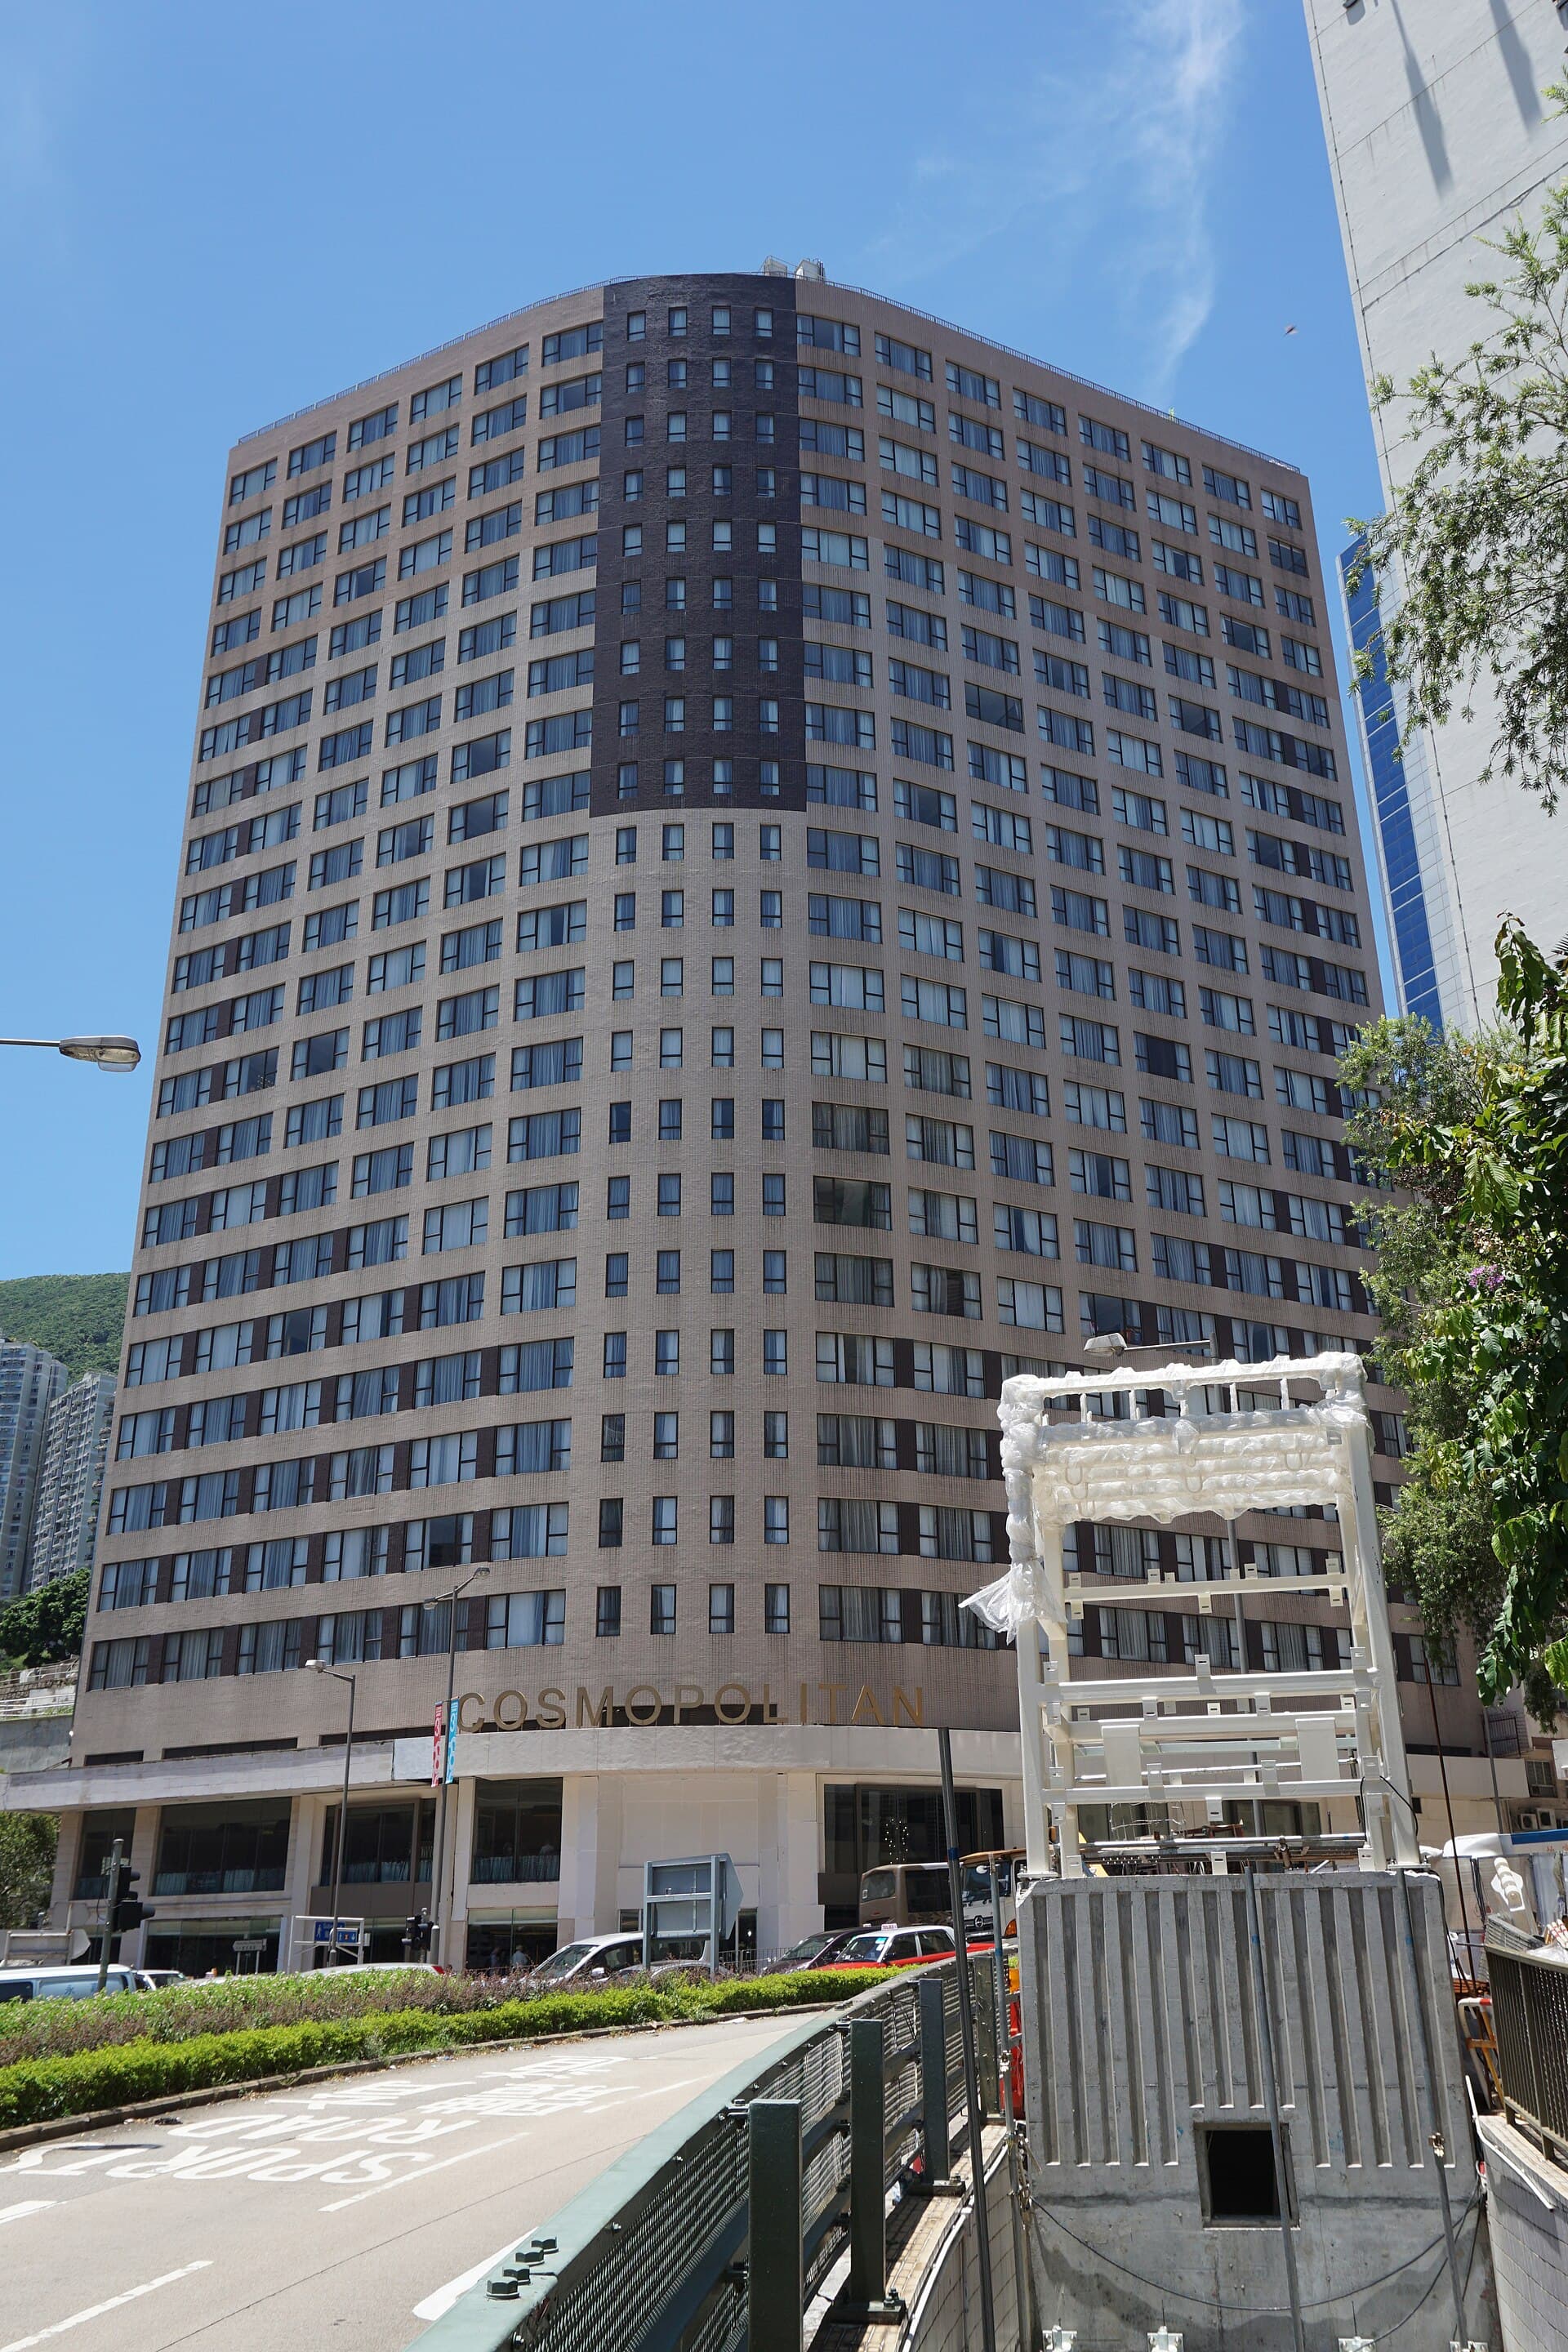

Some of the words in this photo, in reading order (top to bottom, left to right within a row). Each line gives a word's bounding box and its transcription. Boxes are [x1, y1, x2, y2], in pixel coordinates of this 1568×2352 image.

[459, 1684, 923, 1732] COSMOPOLITAN
[167, 2114, 480, 2144] ROAD
[0, 2141, 434, 2183] SPORTS
